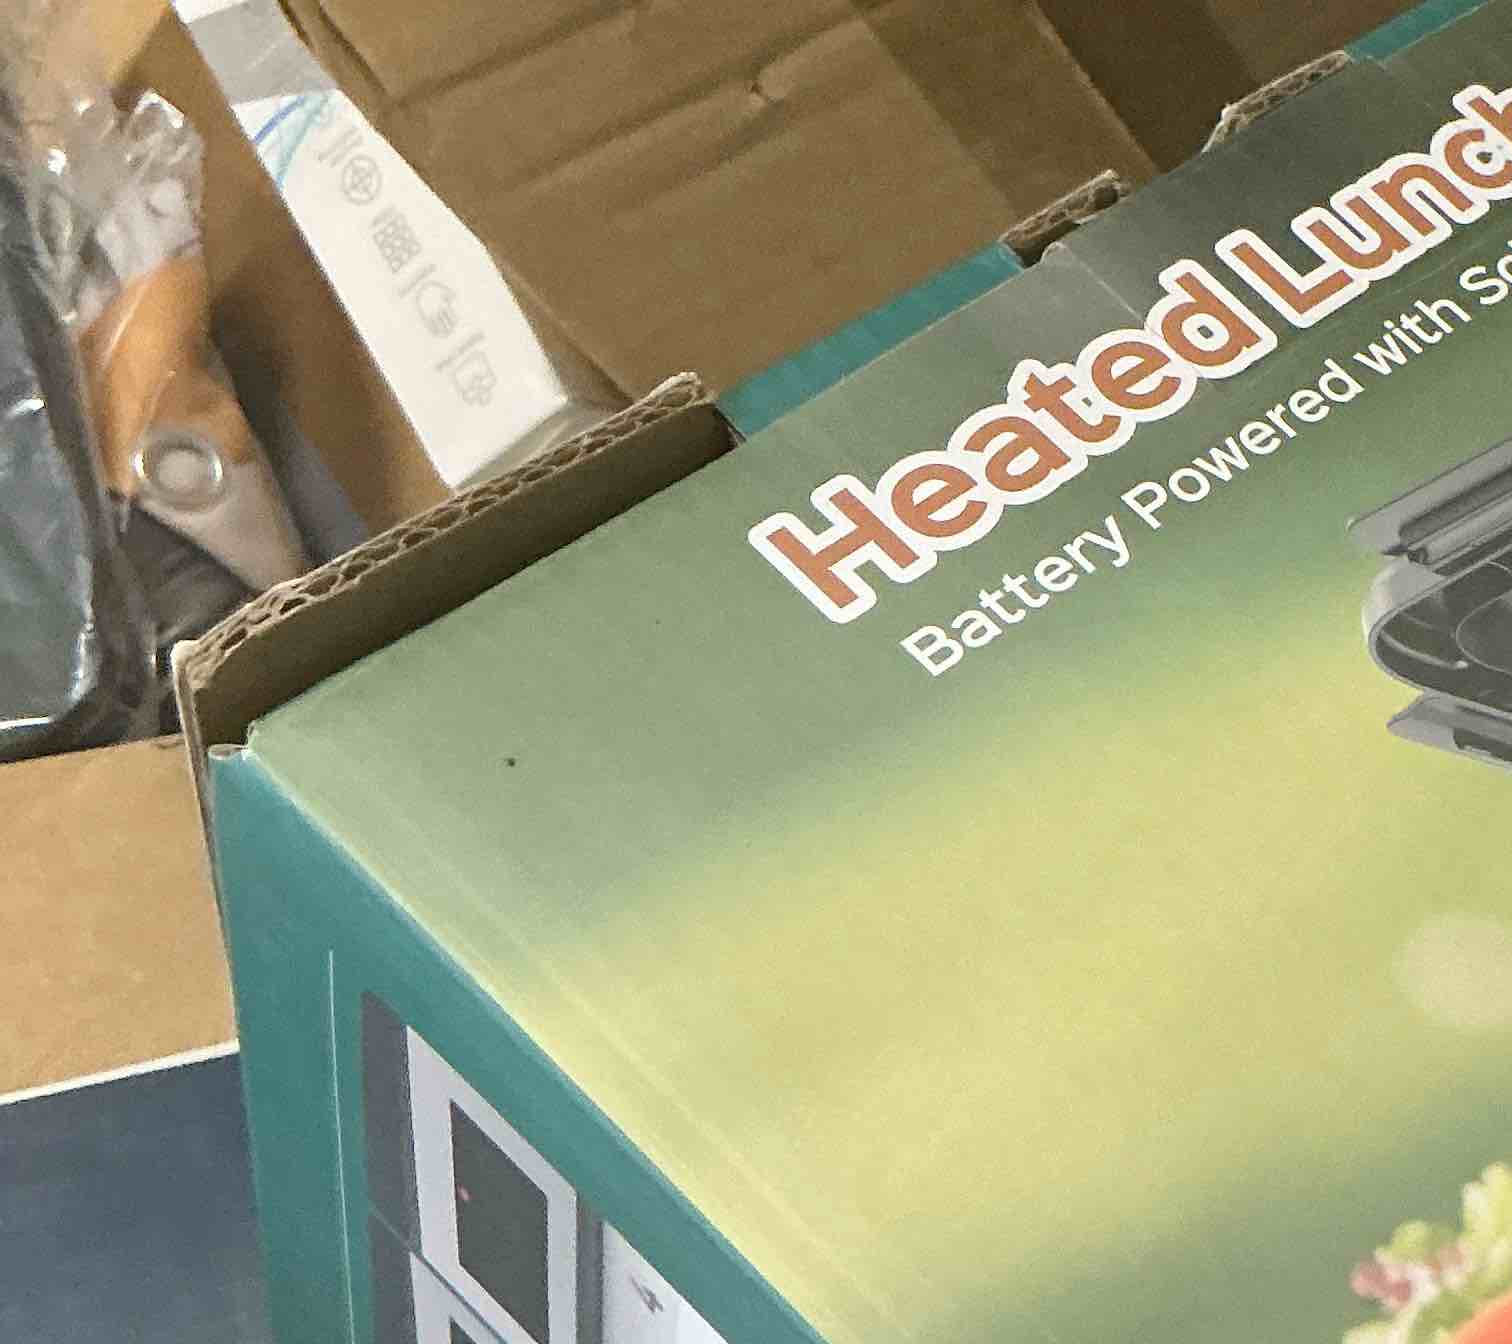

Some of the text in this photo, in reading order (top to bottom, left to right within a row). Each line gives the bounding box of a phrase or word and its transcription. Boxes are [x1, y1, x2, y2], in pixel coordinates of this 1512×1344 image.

[749, 260, 1279, 626] Heated
[900, 513, 1133, 678] Battery
[1120, 361, 1367, 529] Powered
[1353, 292, 1471, 375] with
[631, 1274, 664, 1316] 4
